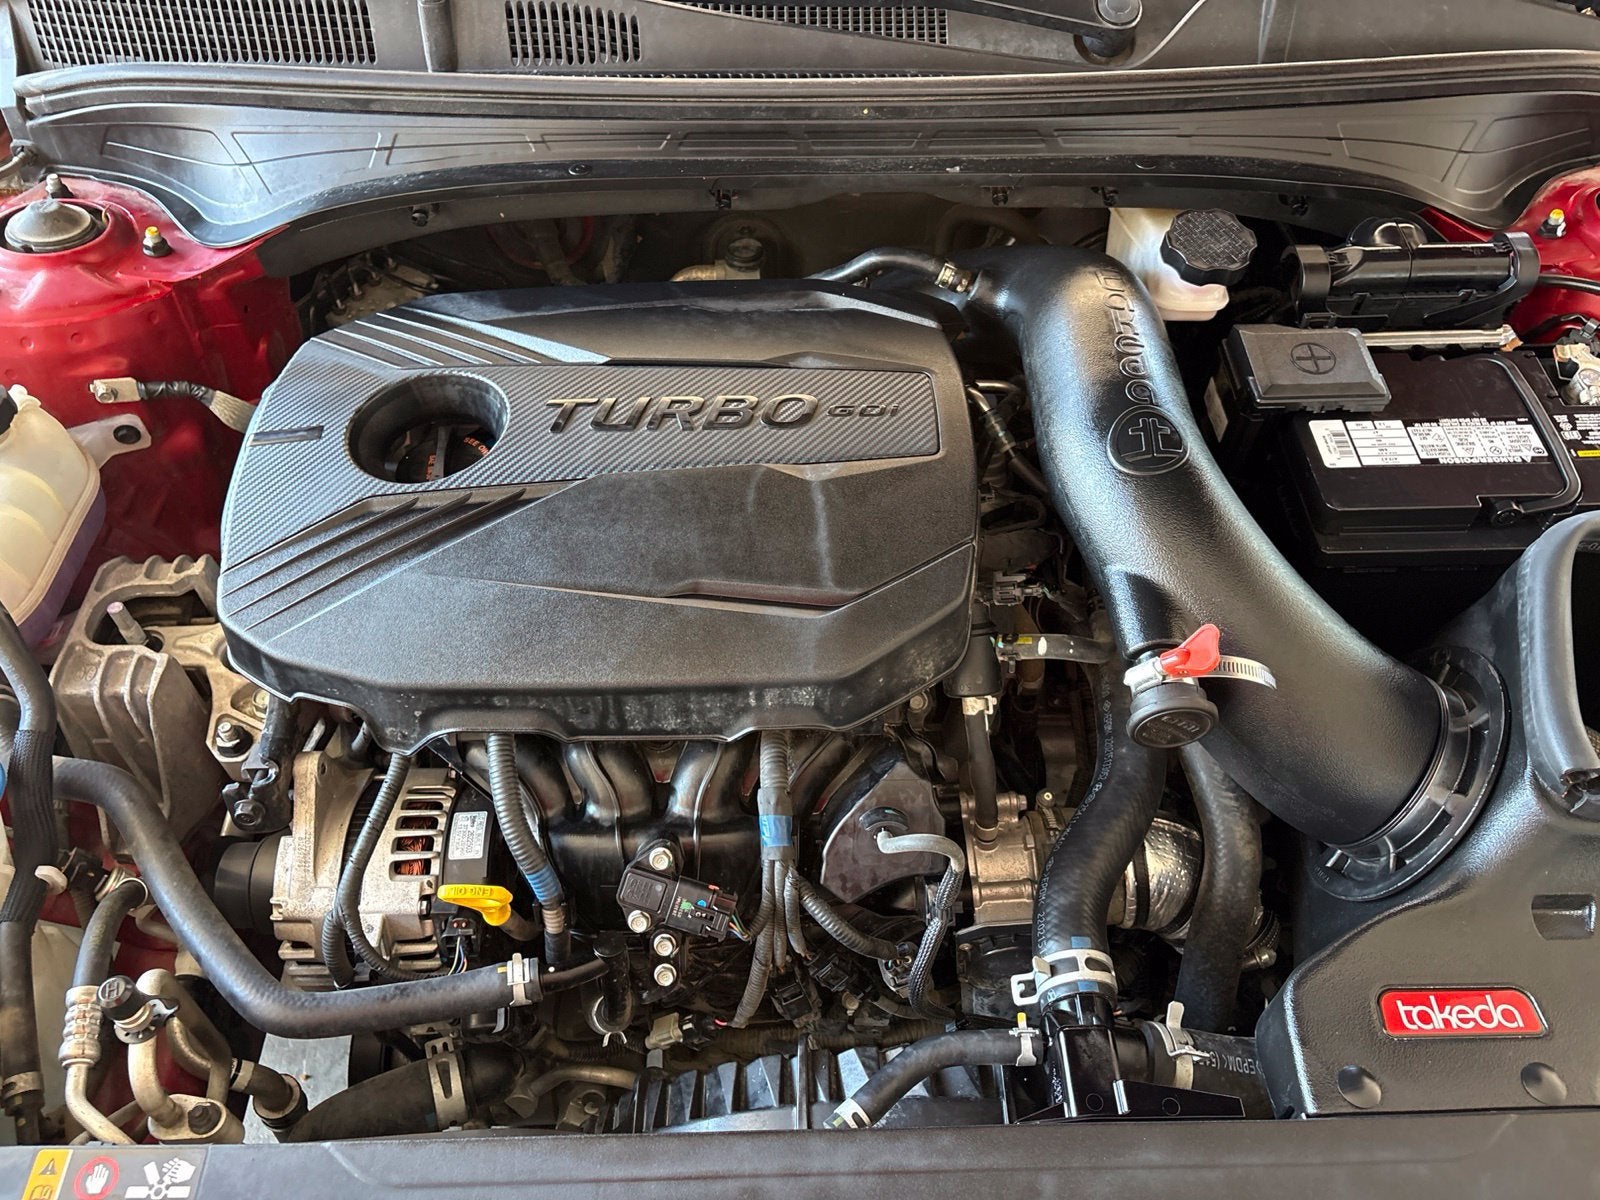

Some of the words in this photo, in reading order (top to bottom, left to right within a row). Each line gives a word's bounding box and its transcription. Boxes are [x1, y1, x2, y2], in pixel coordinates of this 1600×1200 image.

[546, 393, 819, 433] TURBO
[826, 403, 900, 418] GDi
[470, 886, 493, 897] ENG
[1037, 911, 1048, 955] 2202151
[1396, 993, 1525, 1031] takeda
